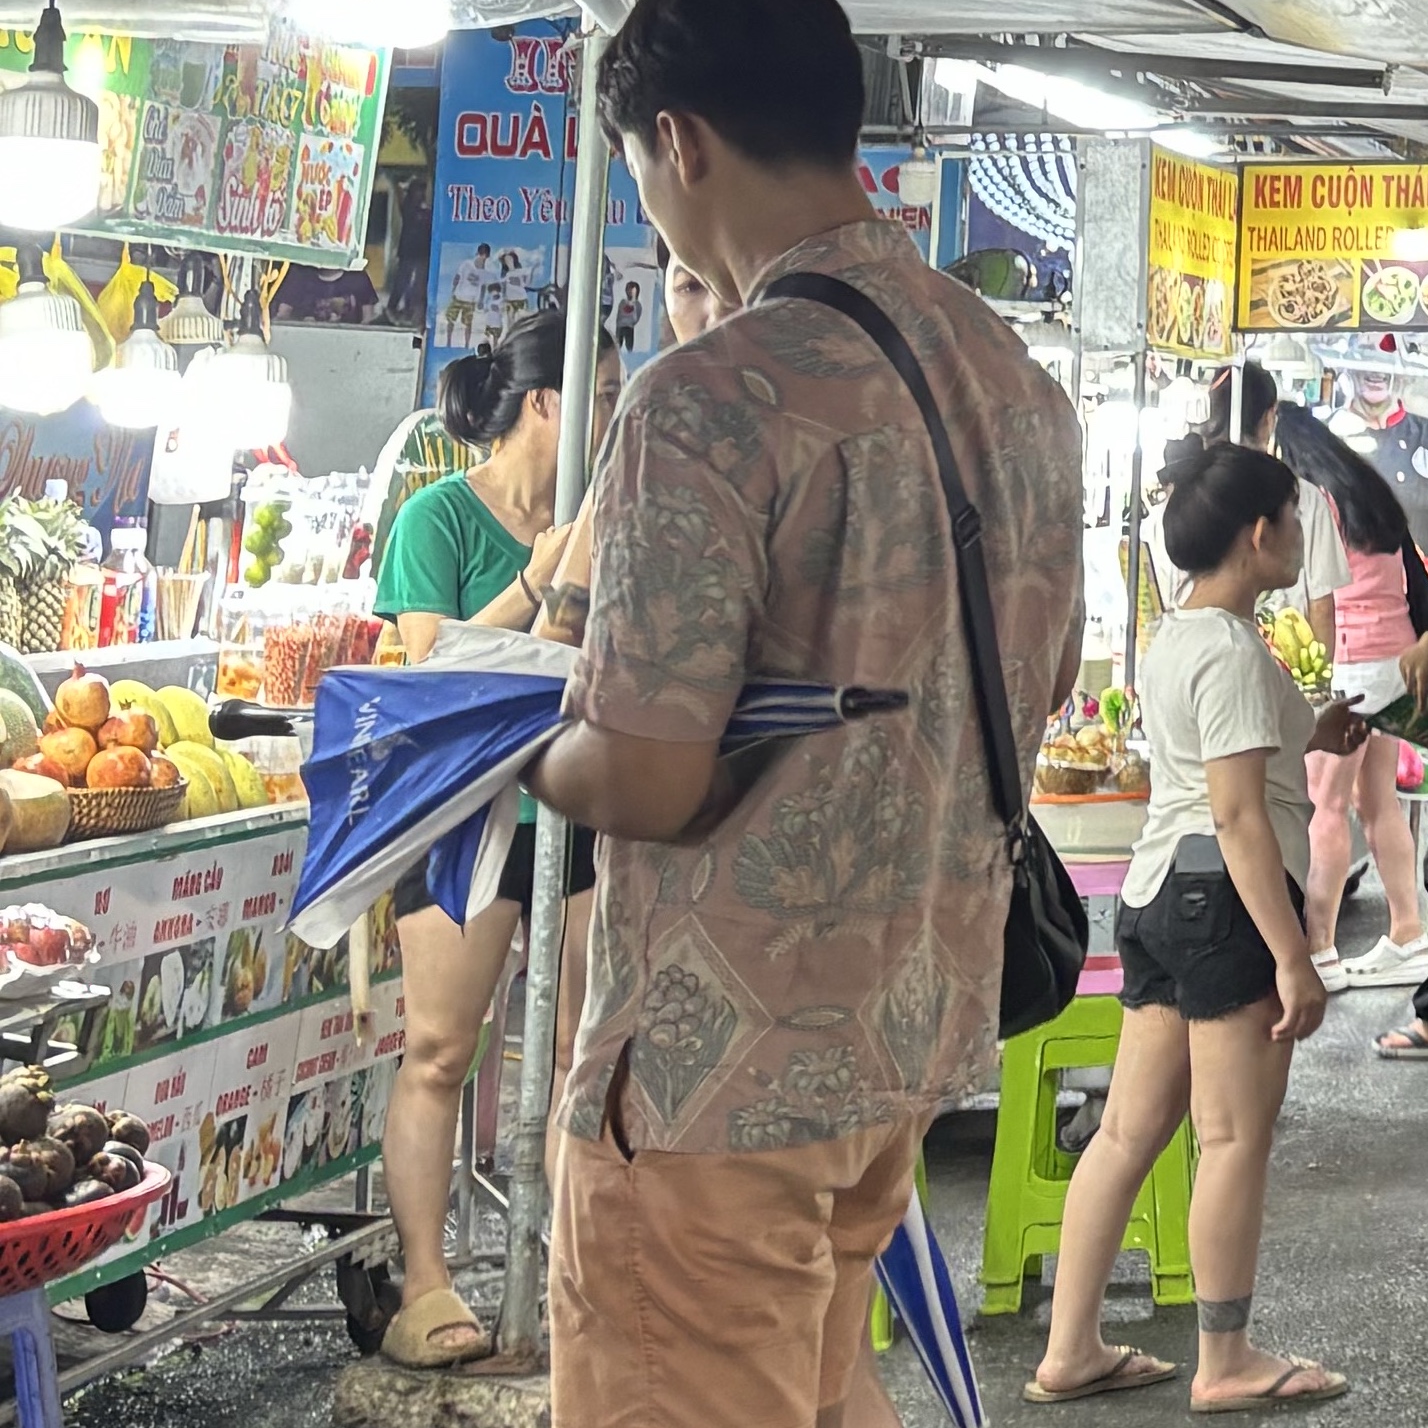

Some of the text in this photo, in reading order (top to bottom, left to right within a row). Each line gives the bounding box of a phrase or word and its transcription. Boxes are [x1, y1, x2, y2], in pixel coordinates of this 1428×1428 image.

[455, 99, 554, 161] QUÀ
[448, 184, 511, 224] Theo
[1253, 175, 1302, 209] KEM
[1311, 166, 1374, 216] CUỘN
[1247, 225, 1327, 253] THAILAND
